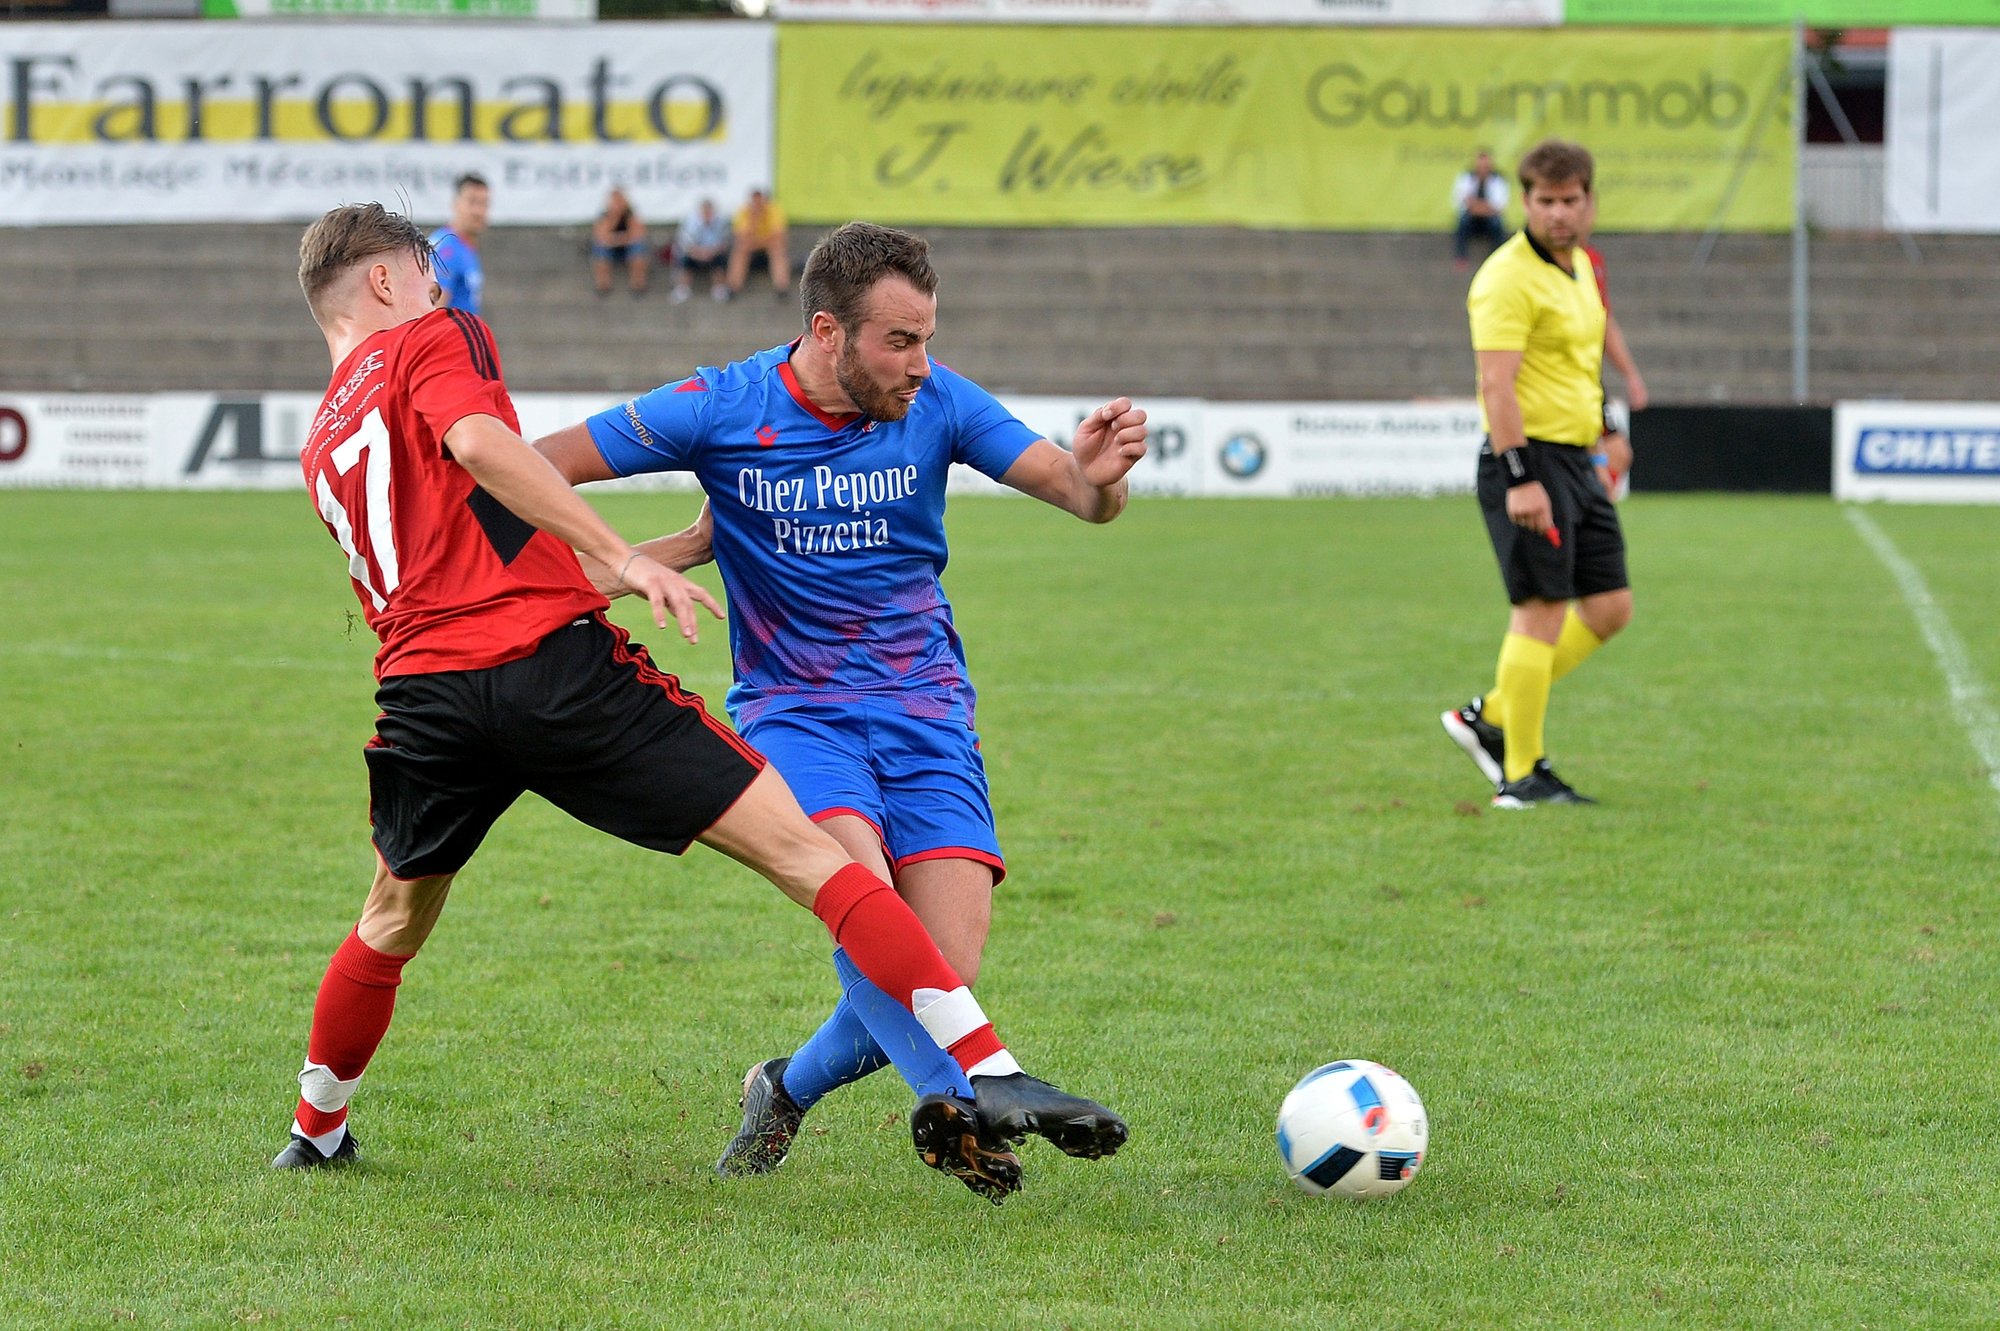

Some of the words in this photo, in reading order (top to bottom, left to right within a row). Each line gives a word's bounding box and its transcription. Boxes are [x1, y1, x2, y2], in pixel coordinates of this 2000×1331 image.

[5, 56, 727, 144] Farronato
[1304, 62, 1749, 130] Gowimmob
[3, 157, 201, 192] Montage
[998, 122, 1206, 194] Wiese
[315, 406, 400, 614] 17
[738, 468, 808, 513] Chez
[813, 464, 918, 513] Pepone
[772, 511, 890, 556] Pizzeria
